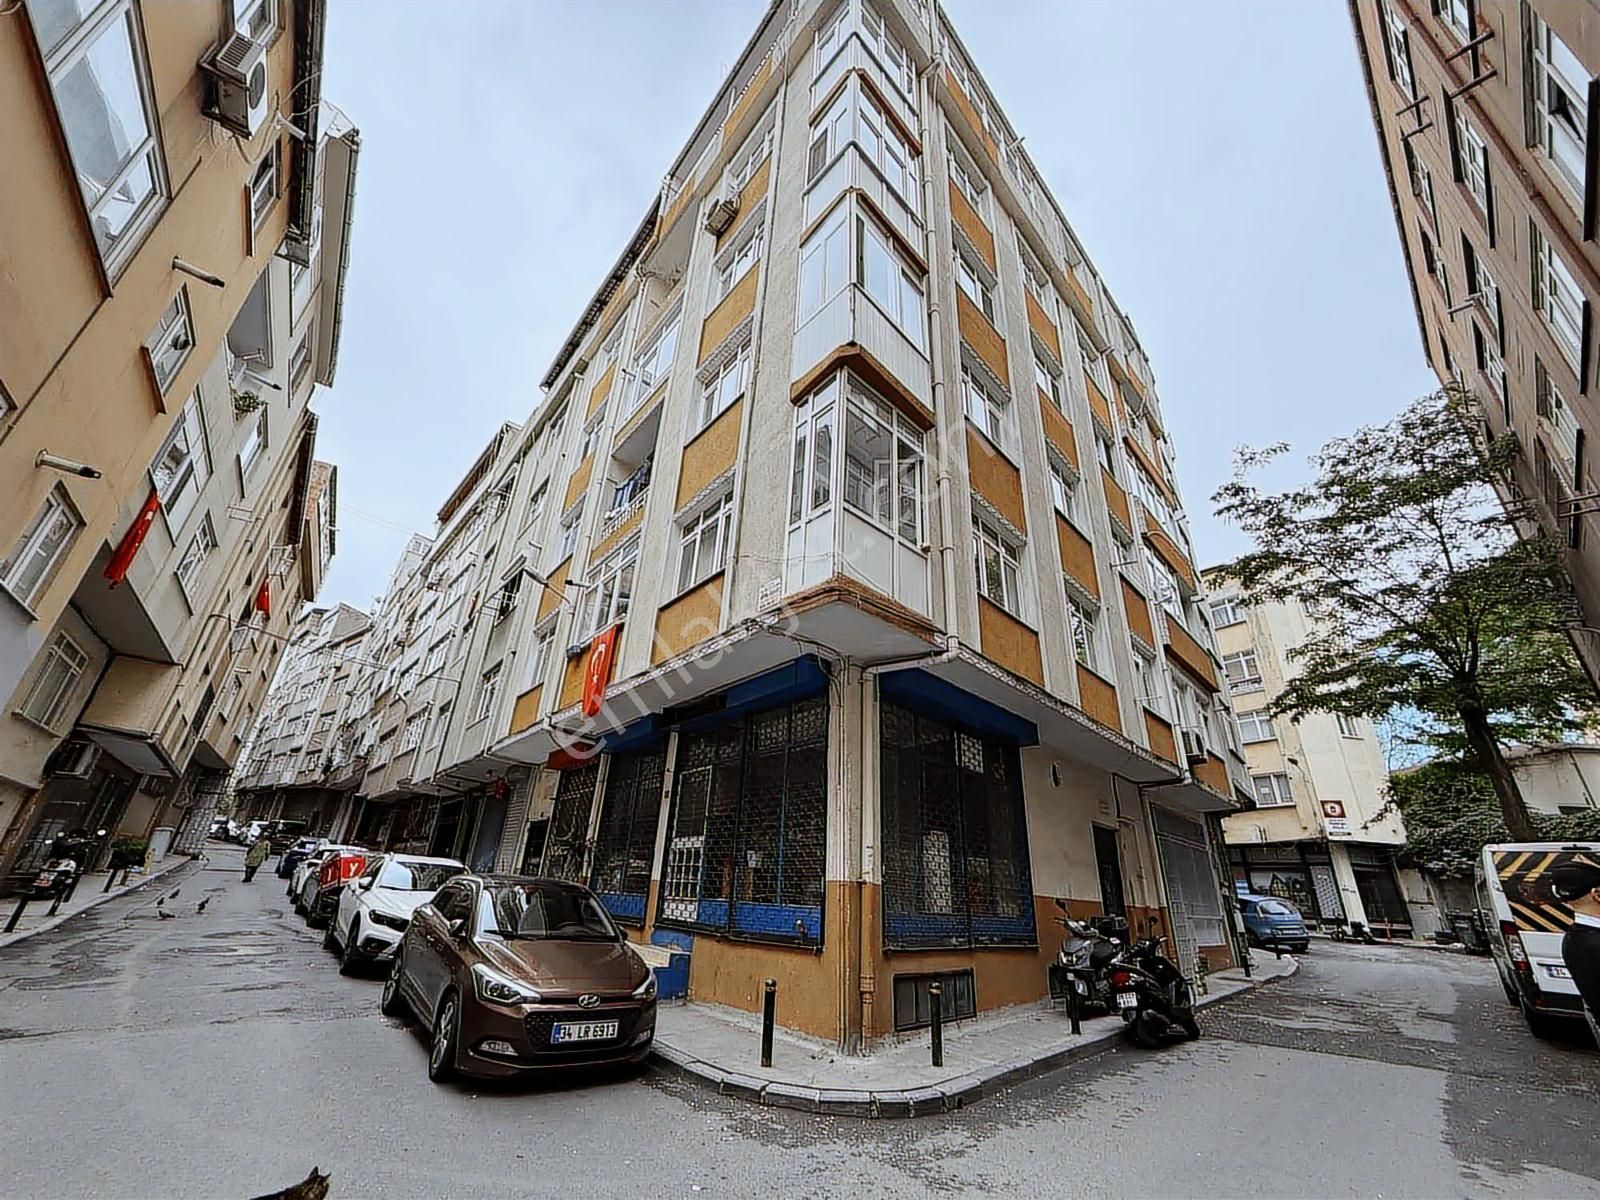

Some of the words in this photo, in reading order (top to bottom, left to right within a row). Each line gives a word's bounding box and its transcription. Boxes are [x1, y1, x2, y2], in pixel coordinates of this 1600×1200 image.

[559, 1025, 572, 1039] 34
[577, 1025, 591, 1039] LR
[592, 1024, 617, 1037] 6913
